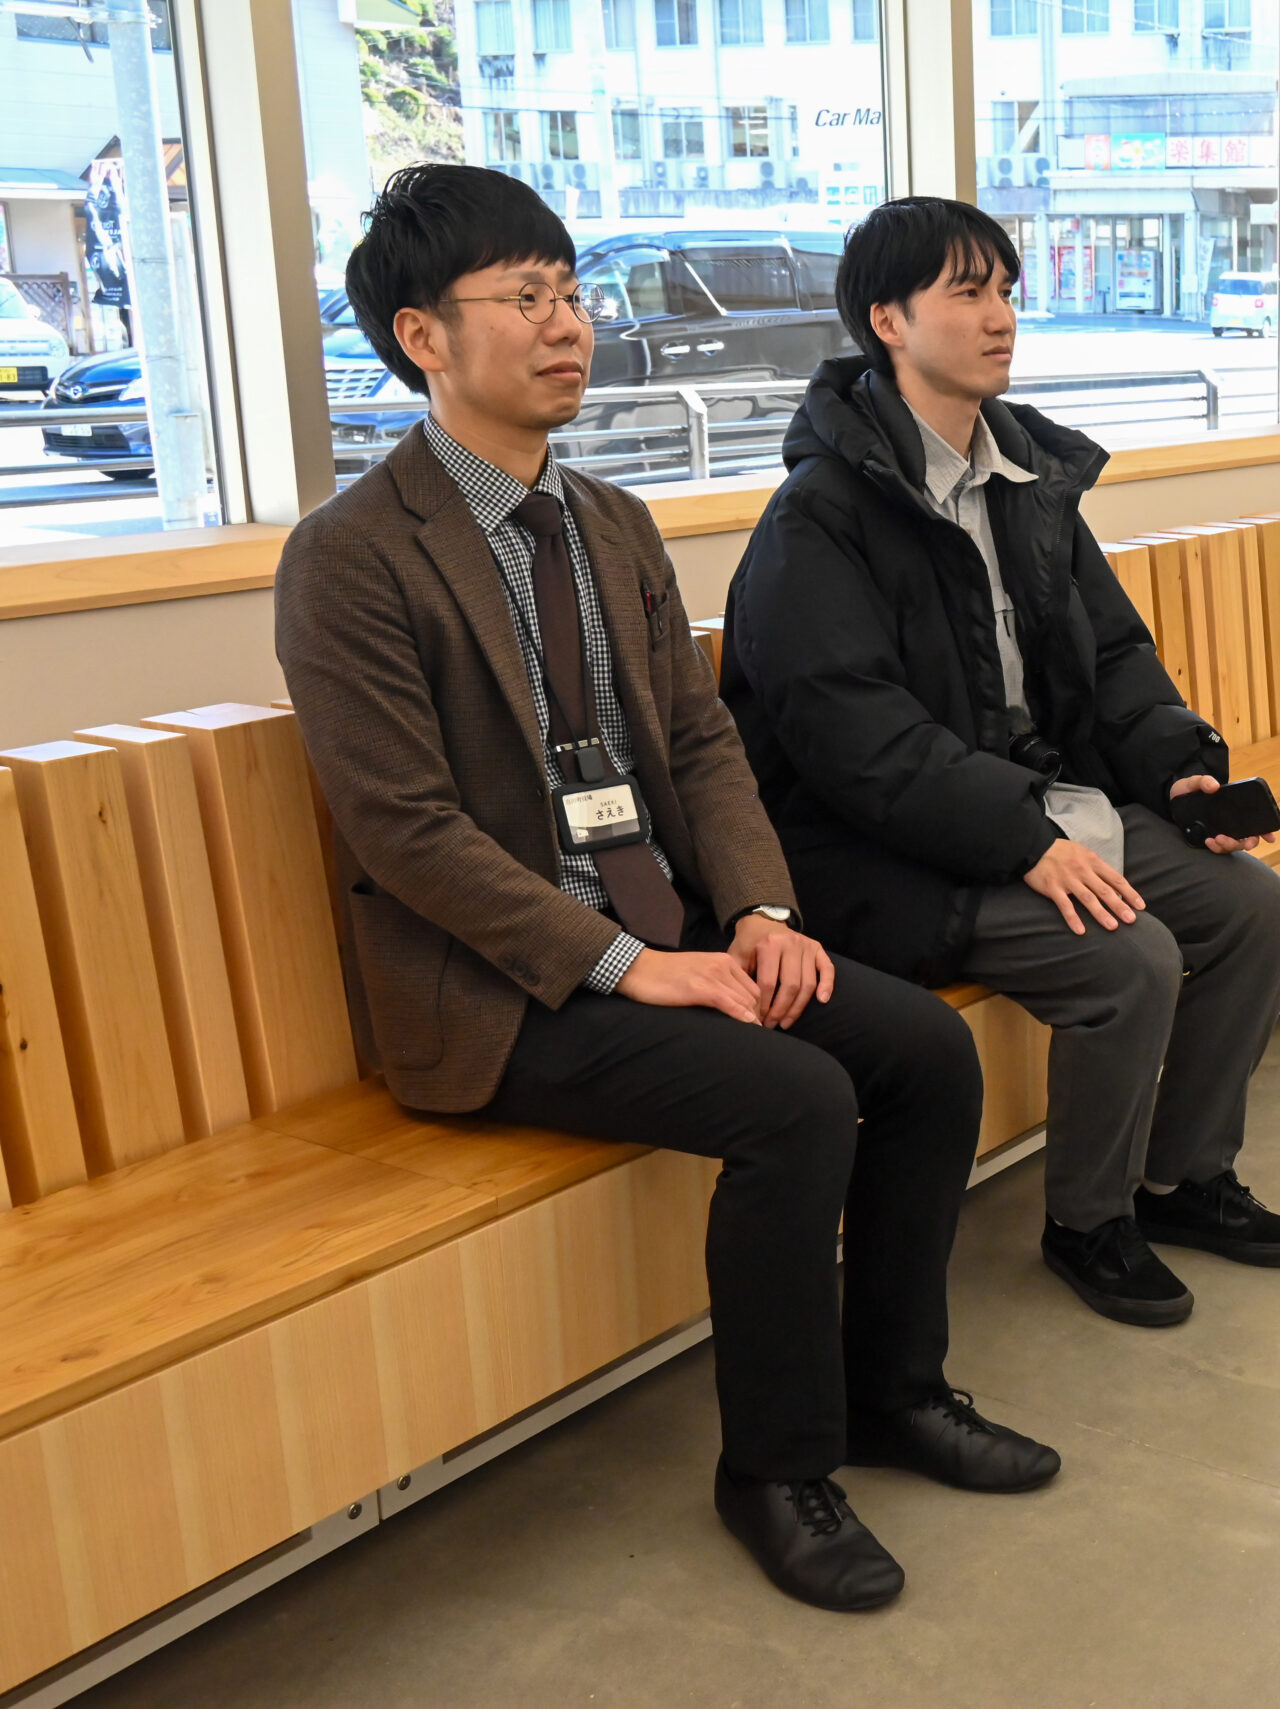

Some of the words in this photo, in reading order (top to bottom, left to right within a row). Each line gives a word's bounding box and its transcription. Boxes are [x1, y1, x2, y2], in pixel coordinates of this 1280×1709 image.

[815, 109, 849, 127] Car
[596, 805, 625, 820] さえき
